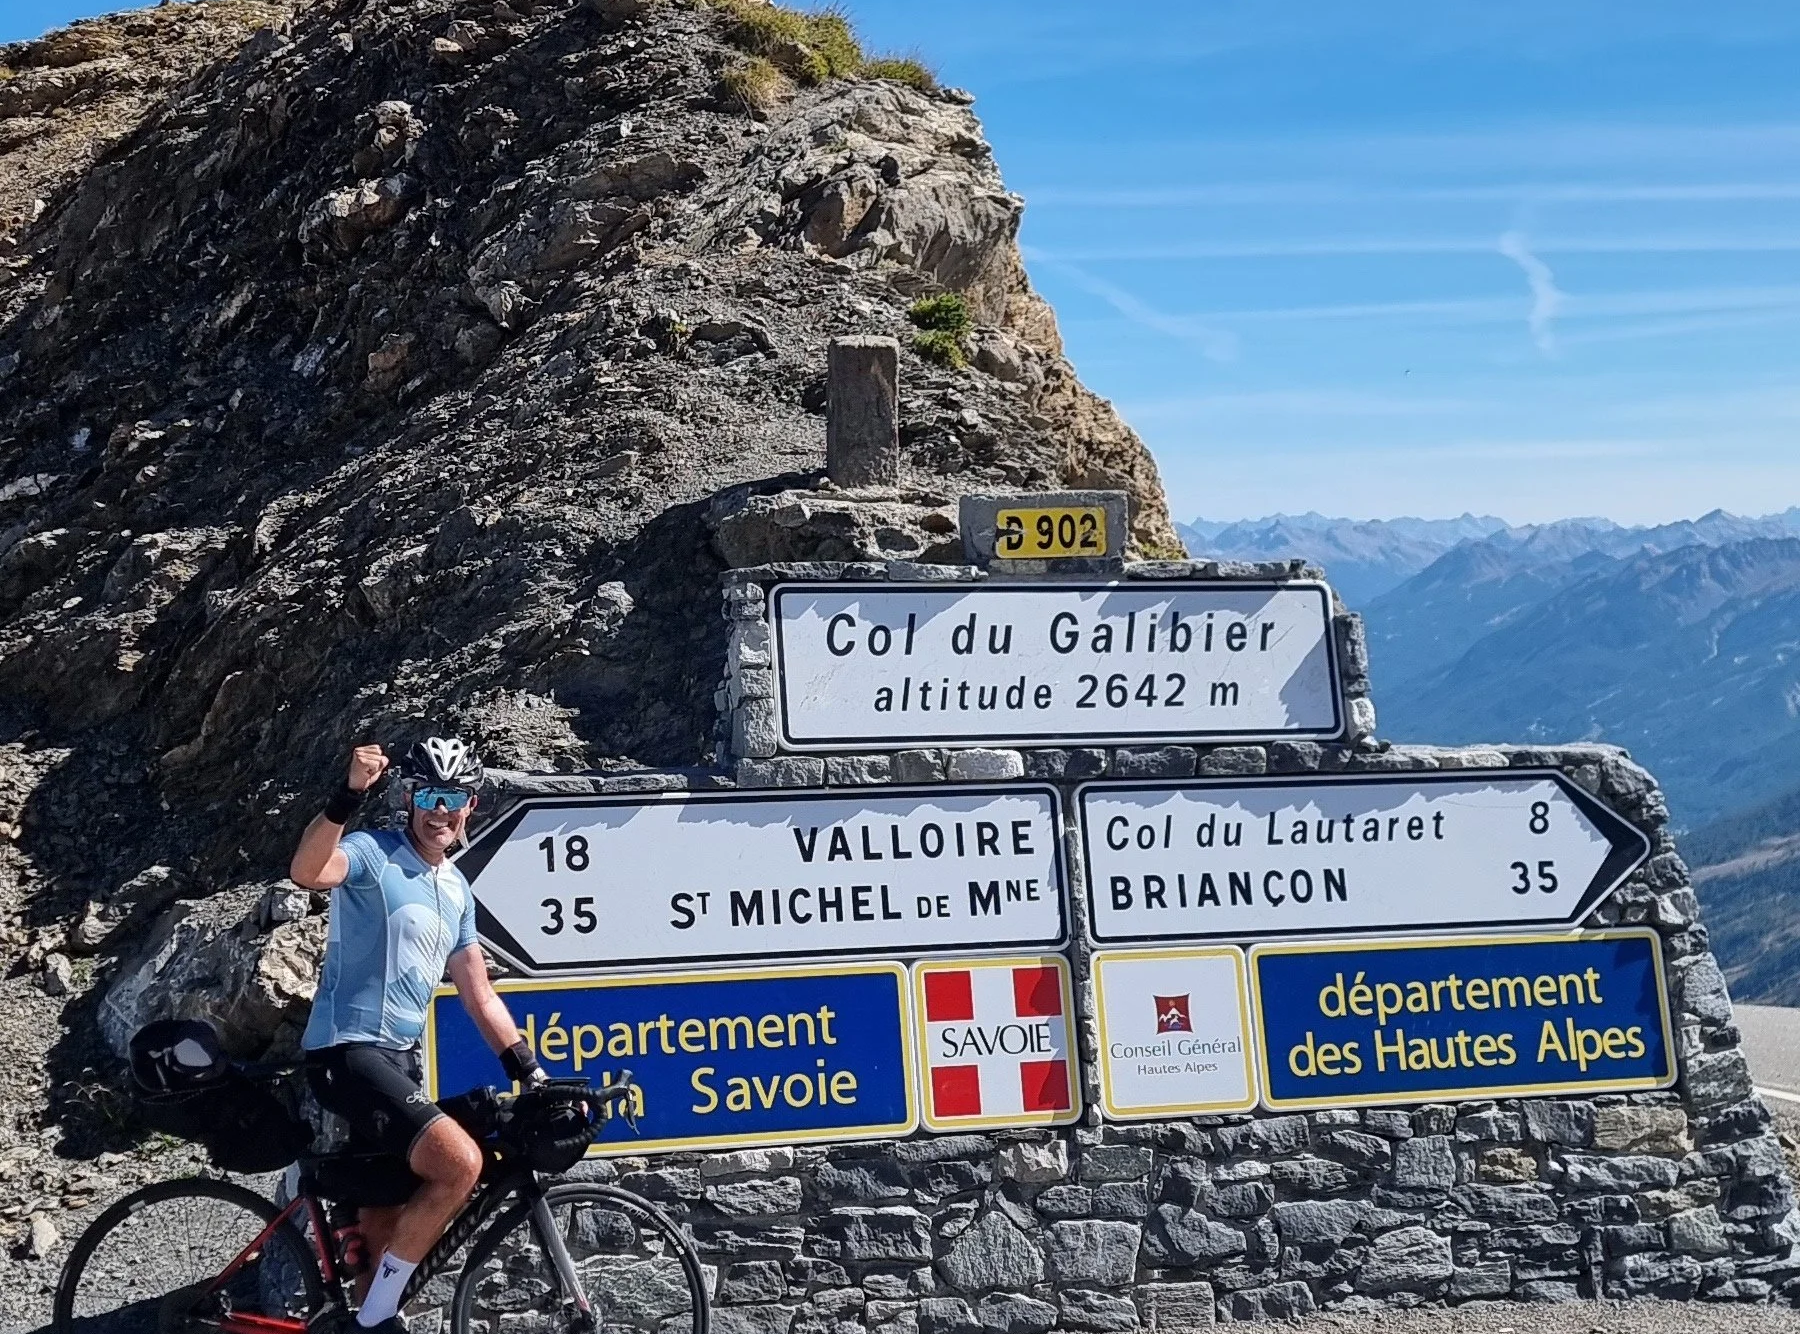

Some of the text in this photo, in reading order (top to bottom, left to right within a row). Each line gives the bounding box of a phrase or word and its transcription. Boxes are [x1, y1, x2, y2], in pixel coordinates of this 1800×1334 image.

[1006, 513, 1097, 550] D 902
[825, 610, 1277, 657] Col du Galibier
[873, 674, 1240, 713] altitude 2642 m
[538, 820, 1034, 873] 18 VALLOIRE
[1106, 801, 1550, 851] Col du Lautaret 8
[540, 897, 598, 936] 35
[730, 885, 902, 926] MICHEL
[1109, 861, 1560, 912] BRIANÇON 35
[1318, 966, 1603, 1026] département
[515, 1004, 837, 1071] département
[941, 1022, 1053, 1059] SAVOIE
[1110, 1035, 1242, 1059] Conseil Général
[1287, 1017, 1646, 1079] des Hautes Alpes
[690, 1058, 858, 1114] Savoie
[1137, 1062, 1219, 1076] Hautes Alpes
